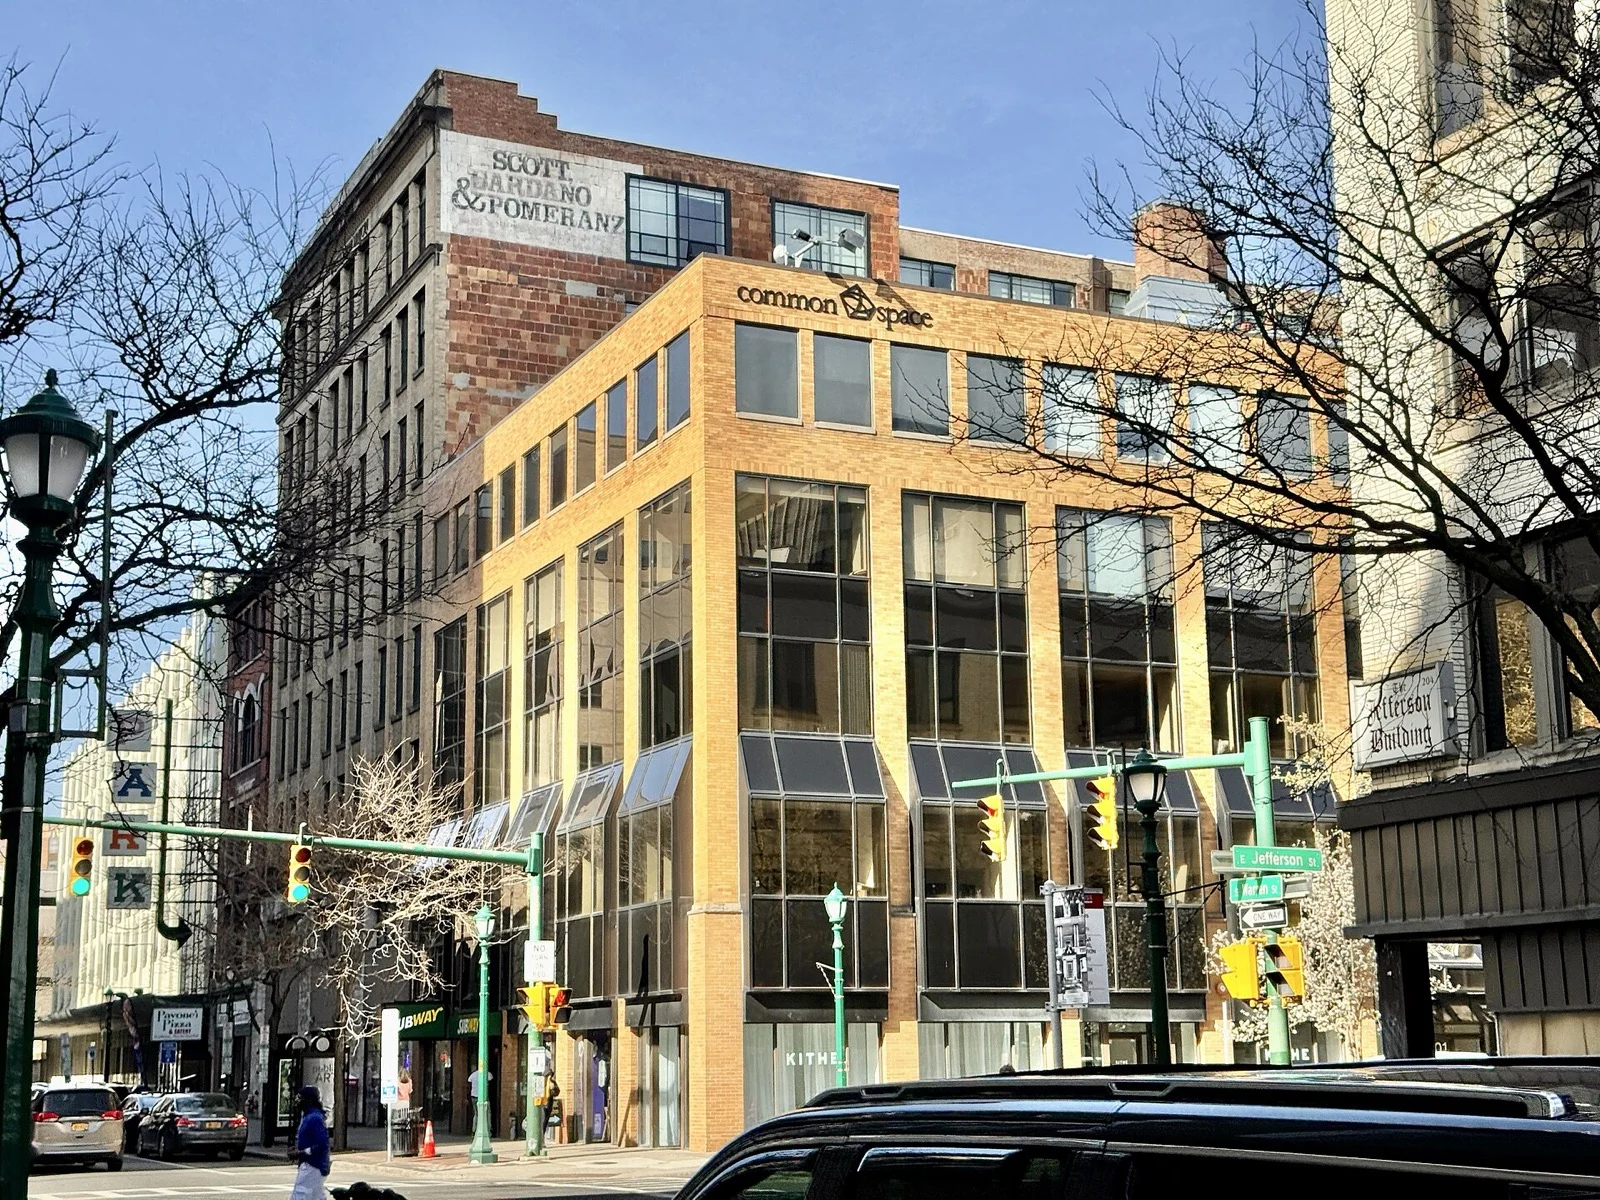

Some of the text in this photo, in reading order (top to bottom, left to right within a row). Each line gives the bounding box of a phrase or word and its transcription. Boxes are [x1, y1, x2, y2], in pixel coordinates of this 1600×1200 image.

[451, 176, 625, 233] & POMERANZ
[737, 285, 934, 331] common space
[1370, 724, 1432, 753] Building
[1240, 854, 1246, 864] E
[1251, 851, 1303, 866] Jefferson
[1253, 911, 1281, 921] ONE WAY
[163, 1019, 191, 1031] Pizza
[398, 1006, 444, 1031] UBWAY
[315, 1072, 333, 1083] AR
